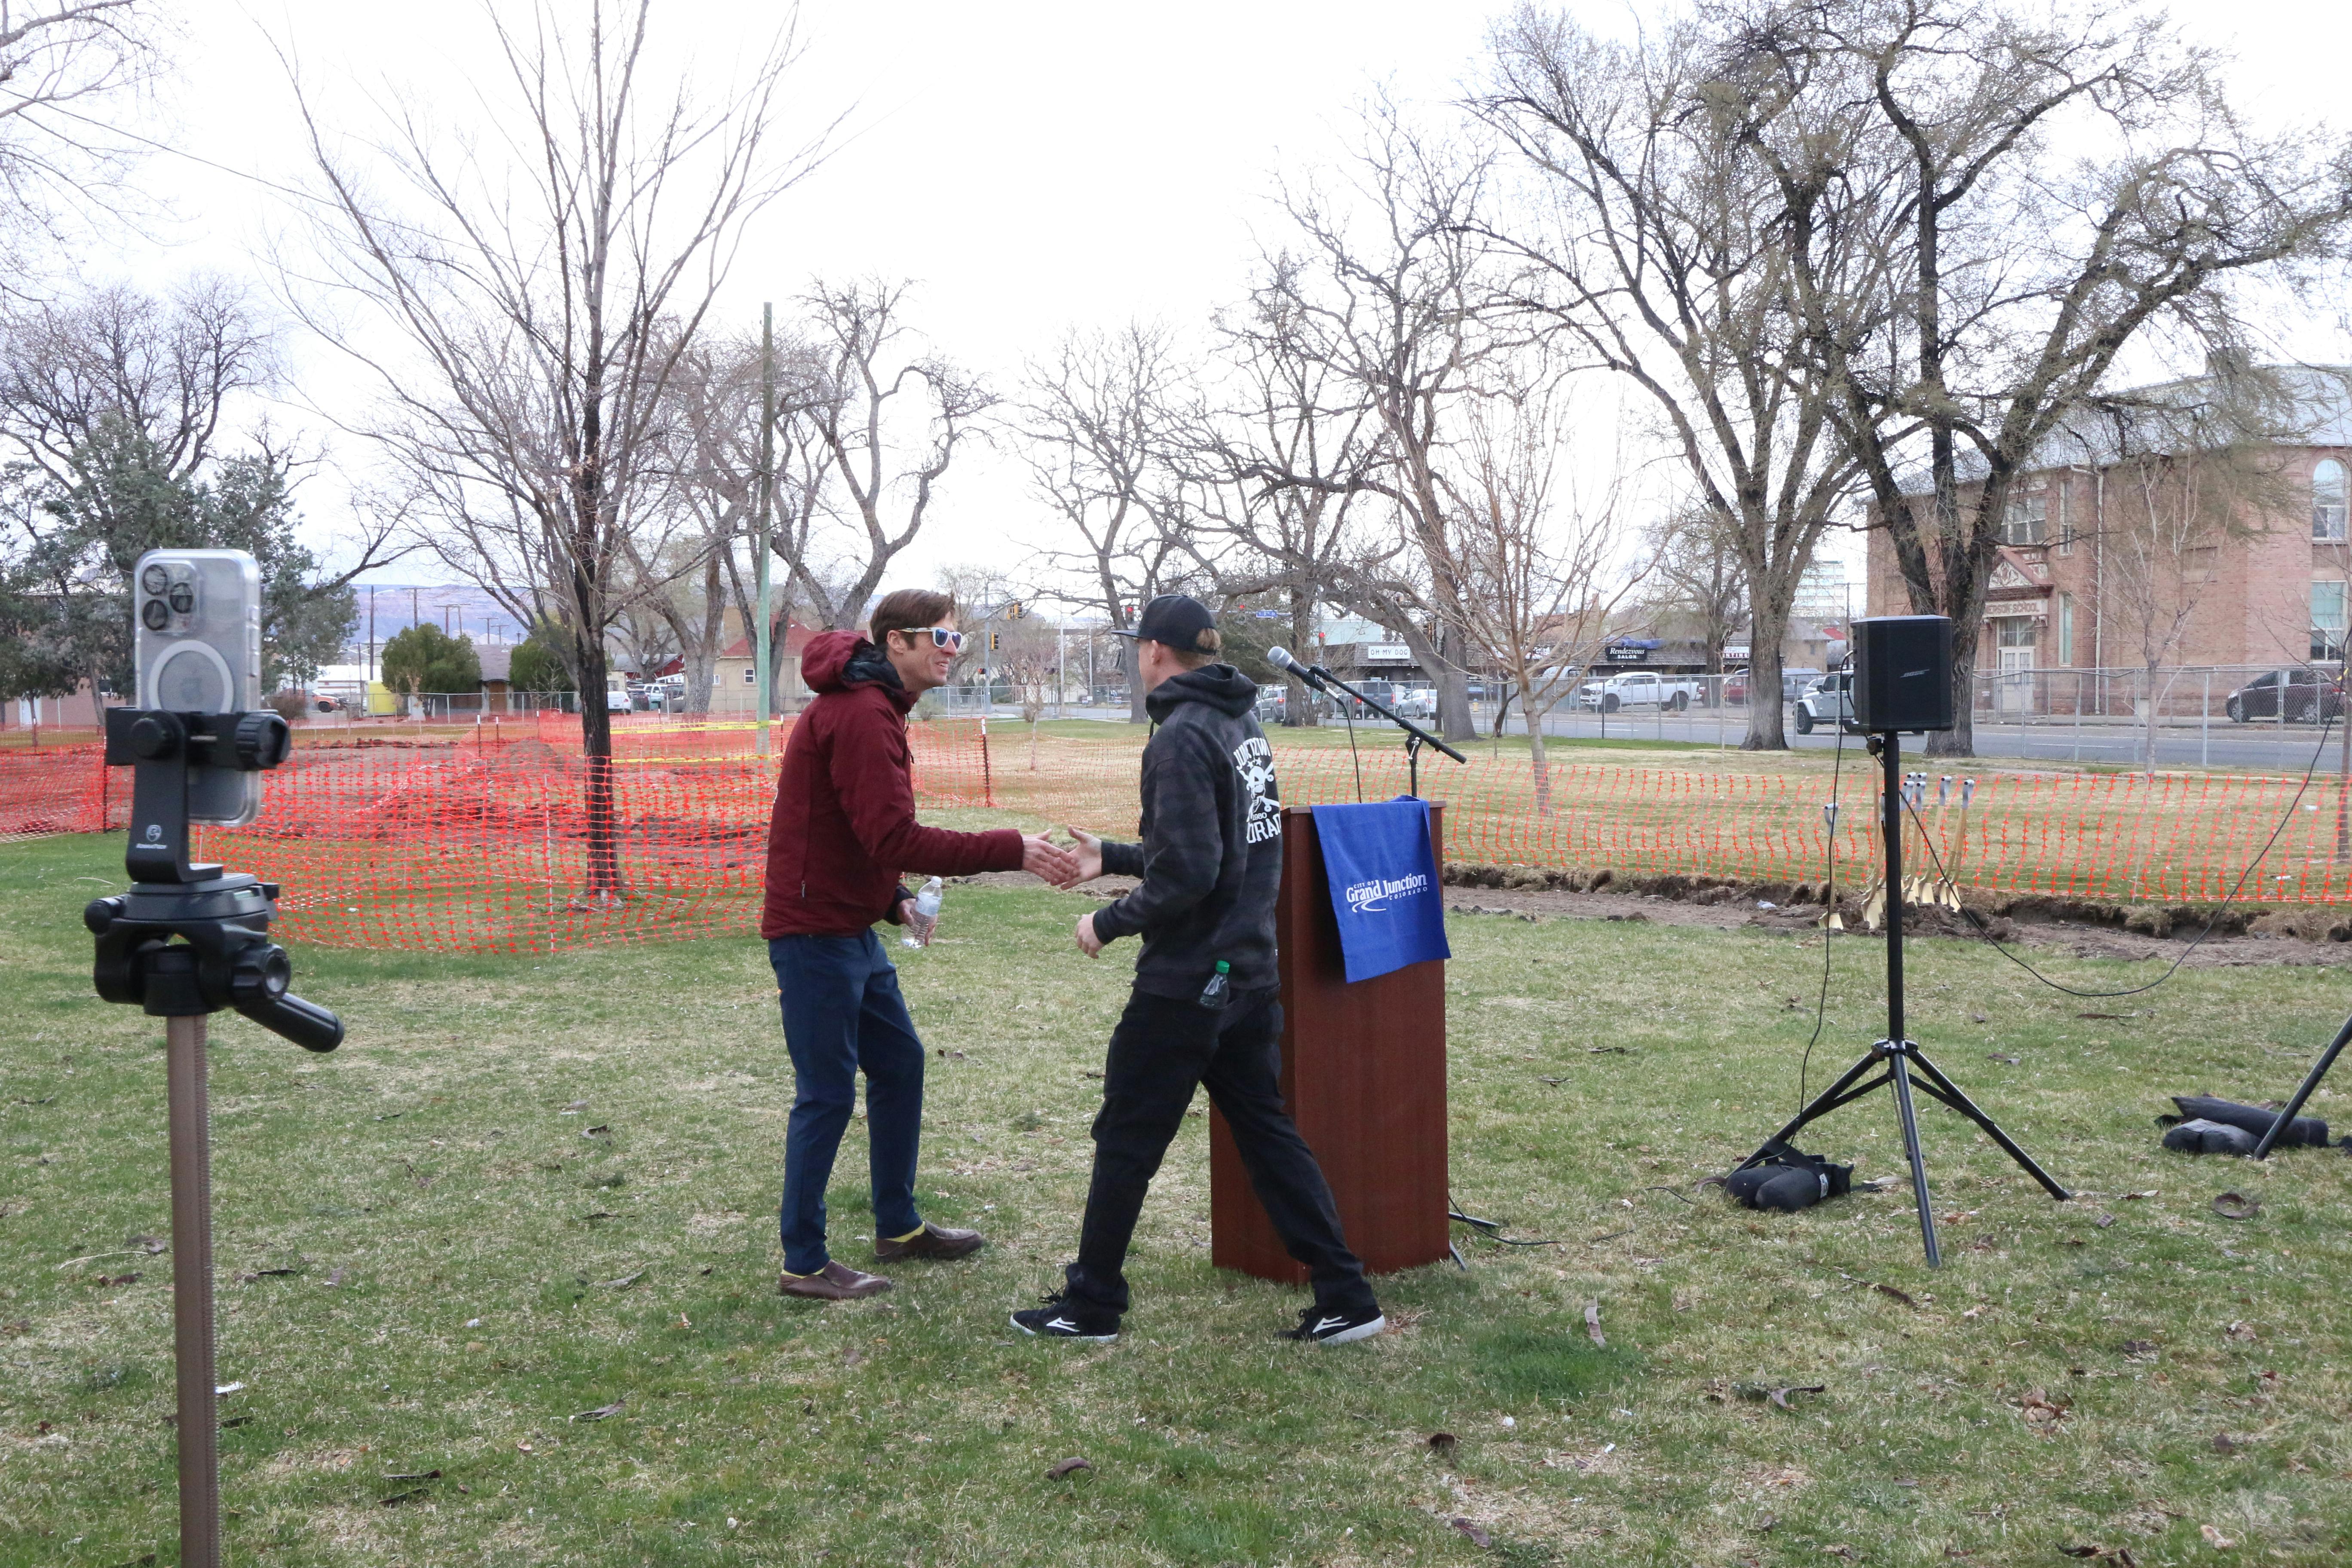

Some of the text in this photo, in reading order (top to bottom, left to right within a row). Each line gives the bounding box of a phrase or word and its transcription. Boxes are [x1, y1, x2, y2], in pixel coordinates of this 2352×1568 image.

[1252, 812, 1268, 821] 1980
[1346, 873, 1427, 903] Grand Junction
[1389, 886, 1427, 900] COLORADO
